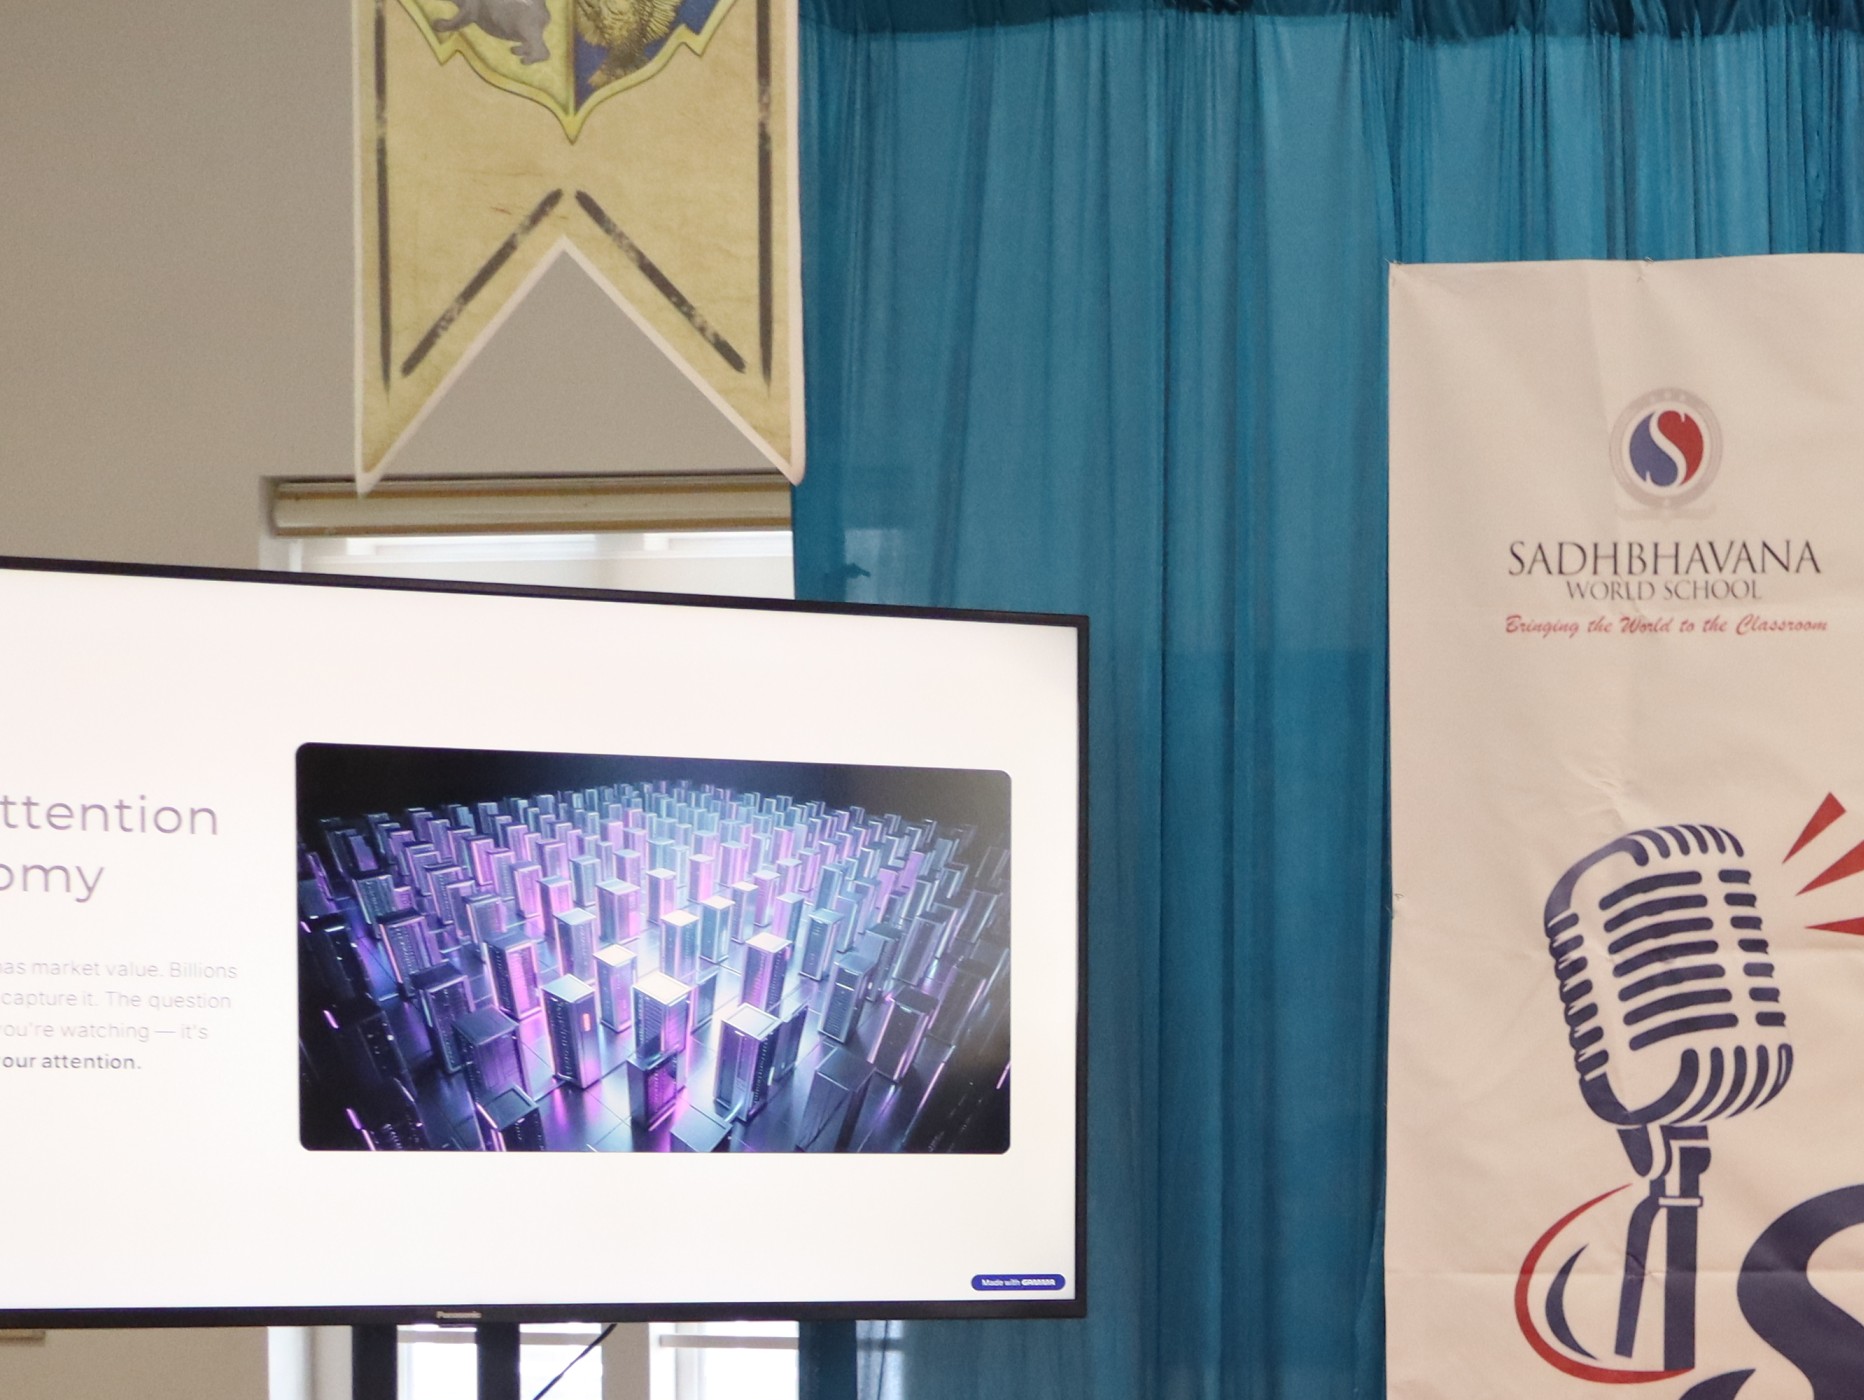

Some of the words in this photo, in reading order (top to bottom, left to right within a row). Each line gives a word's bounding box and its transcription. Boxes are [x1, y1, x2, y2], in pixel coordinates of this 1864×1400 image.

[1508, 540, 1822, 576] SADHBHAVANA
[1566, 579, 1656, 601] WORLD
[1664, 578, 1762, 601] SCHOOL
[1505, 613, 1580, 639] Bringing
[1587, 615, 1612, 634] the
[1620, 615, 1675, 634] World
[1679, 617, 1695, 633] to
[1702, 614, 1728, 634] the
[1736, 613, 1828, 636] Classroom
[31, 960, 100, 977] market
[106, 961, 164, 978] value.
[169, 961, 238, 979] Billions
[1, 990, 77, 1009] capture
[105, 990, 141, 1008] The
[149, 992, 232, 1011] question
[0, 1020, 54, 1038] ou're
[60, 1022, 150, 1043] watching
[180, 1022, 209, 1039] it's
[0, 1055, 37, 1069] our
[41, 1053, 142, 1070] attention.
